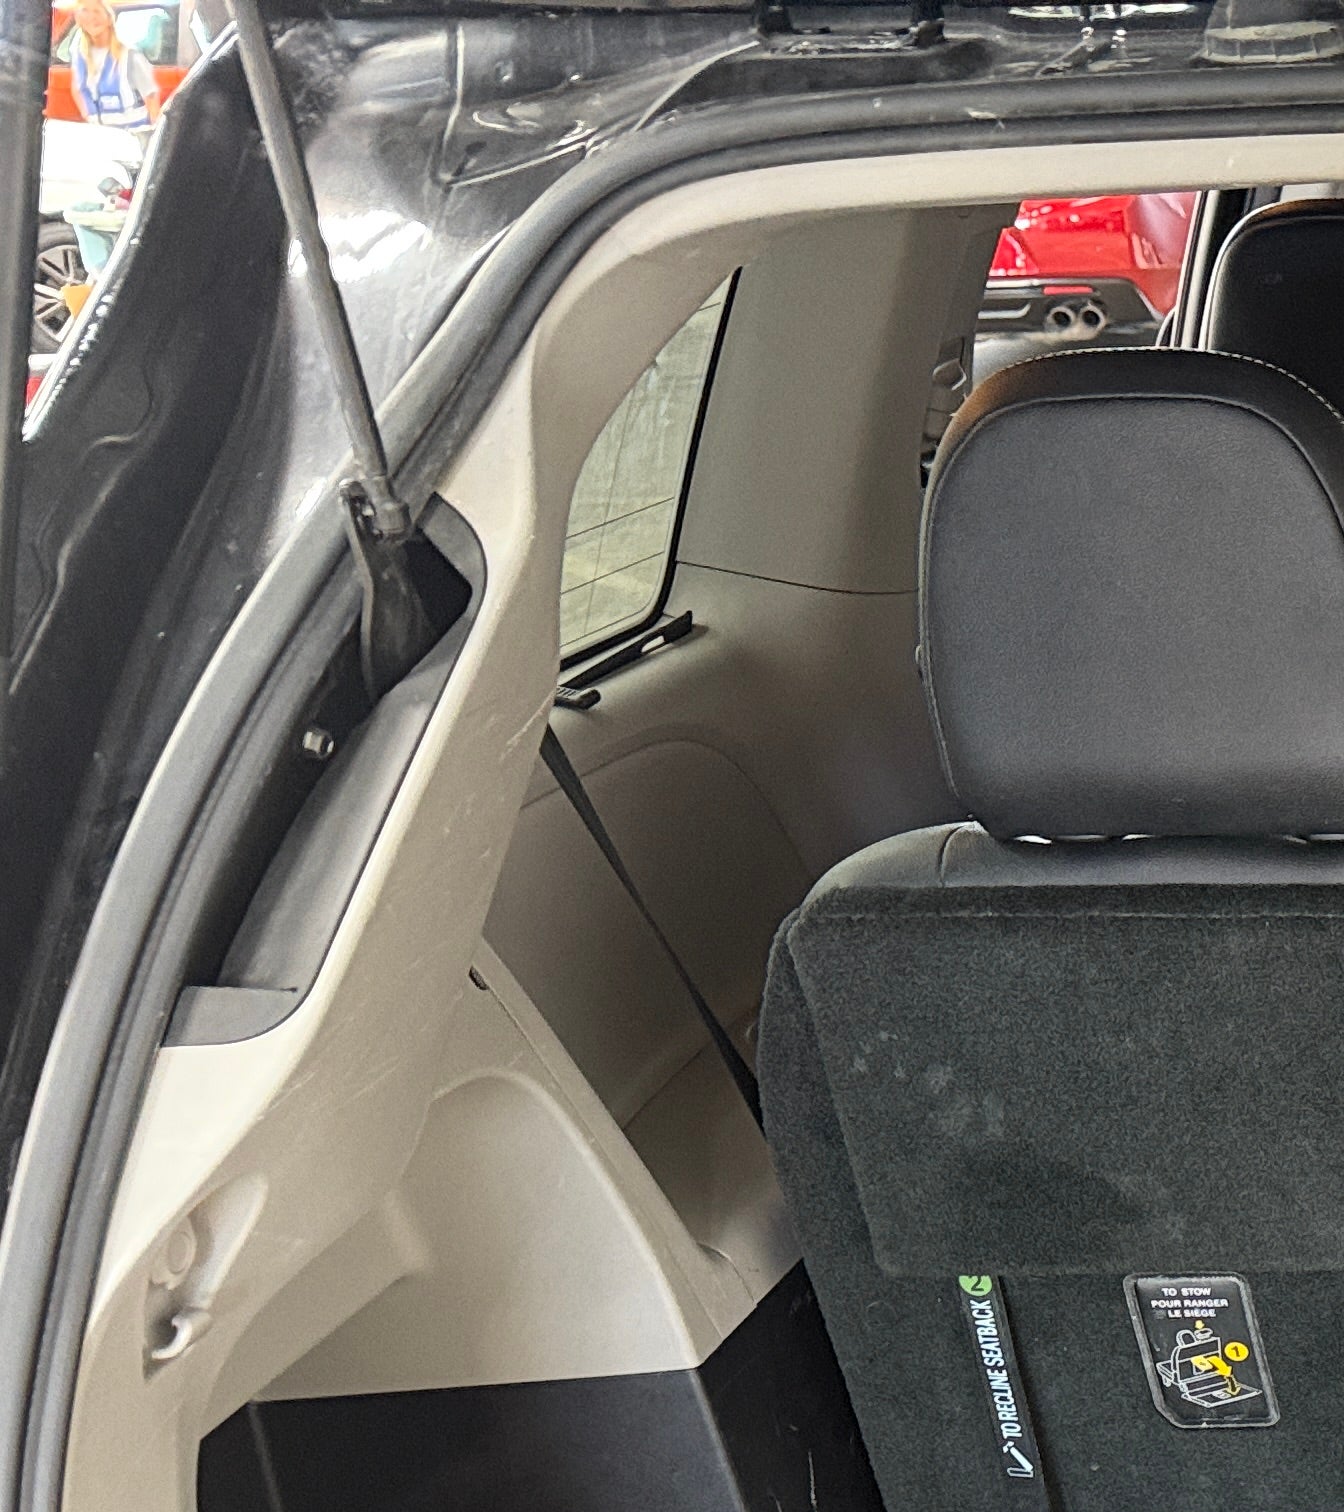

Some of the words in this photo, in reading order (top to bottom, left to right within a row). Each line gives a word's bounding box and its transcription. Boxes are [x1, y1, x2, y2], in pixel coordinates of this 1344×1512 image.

[1161, 1287, 1177, 1297] TO
[1181, 1287, 1212, 1296] STOW
[1150, 1299, 1182, 1308] POUR
[1184, 1299, 1229, 1308] RANGER
[1167, 1309, 1183, 1318] LE
[969, 1299, 1005, 1368] SEATBACK
[986, 1368, 1019, 1422] RECLINE
[1000, 1422, 1023, 1439] TO
